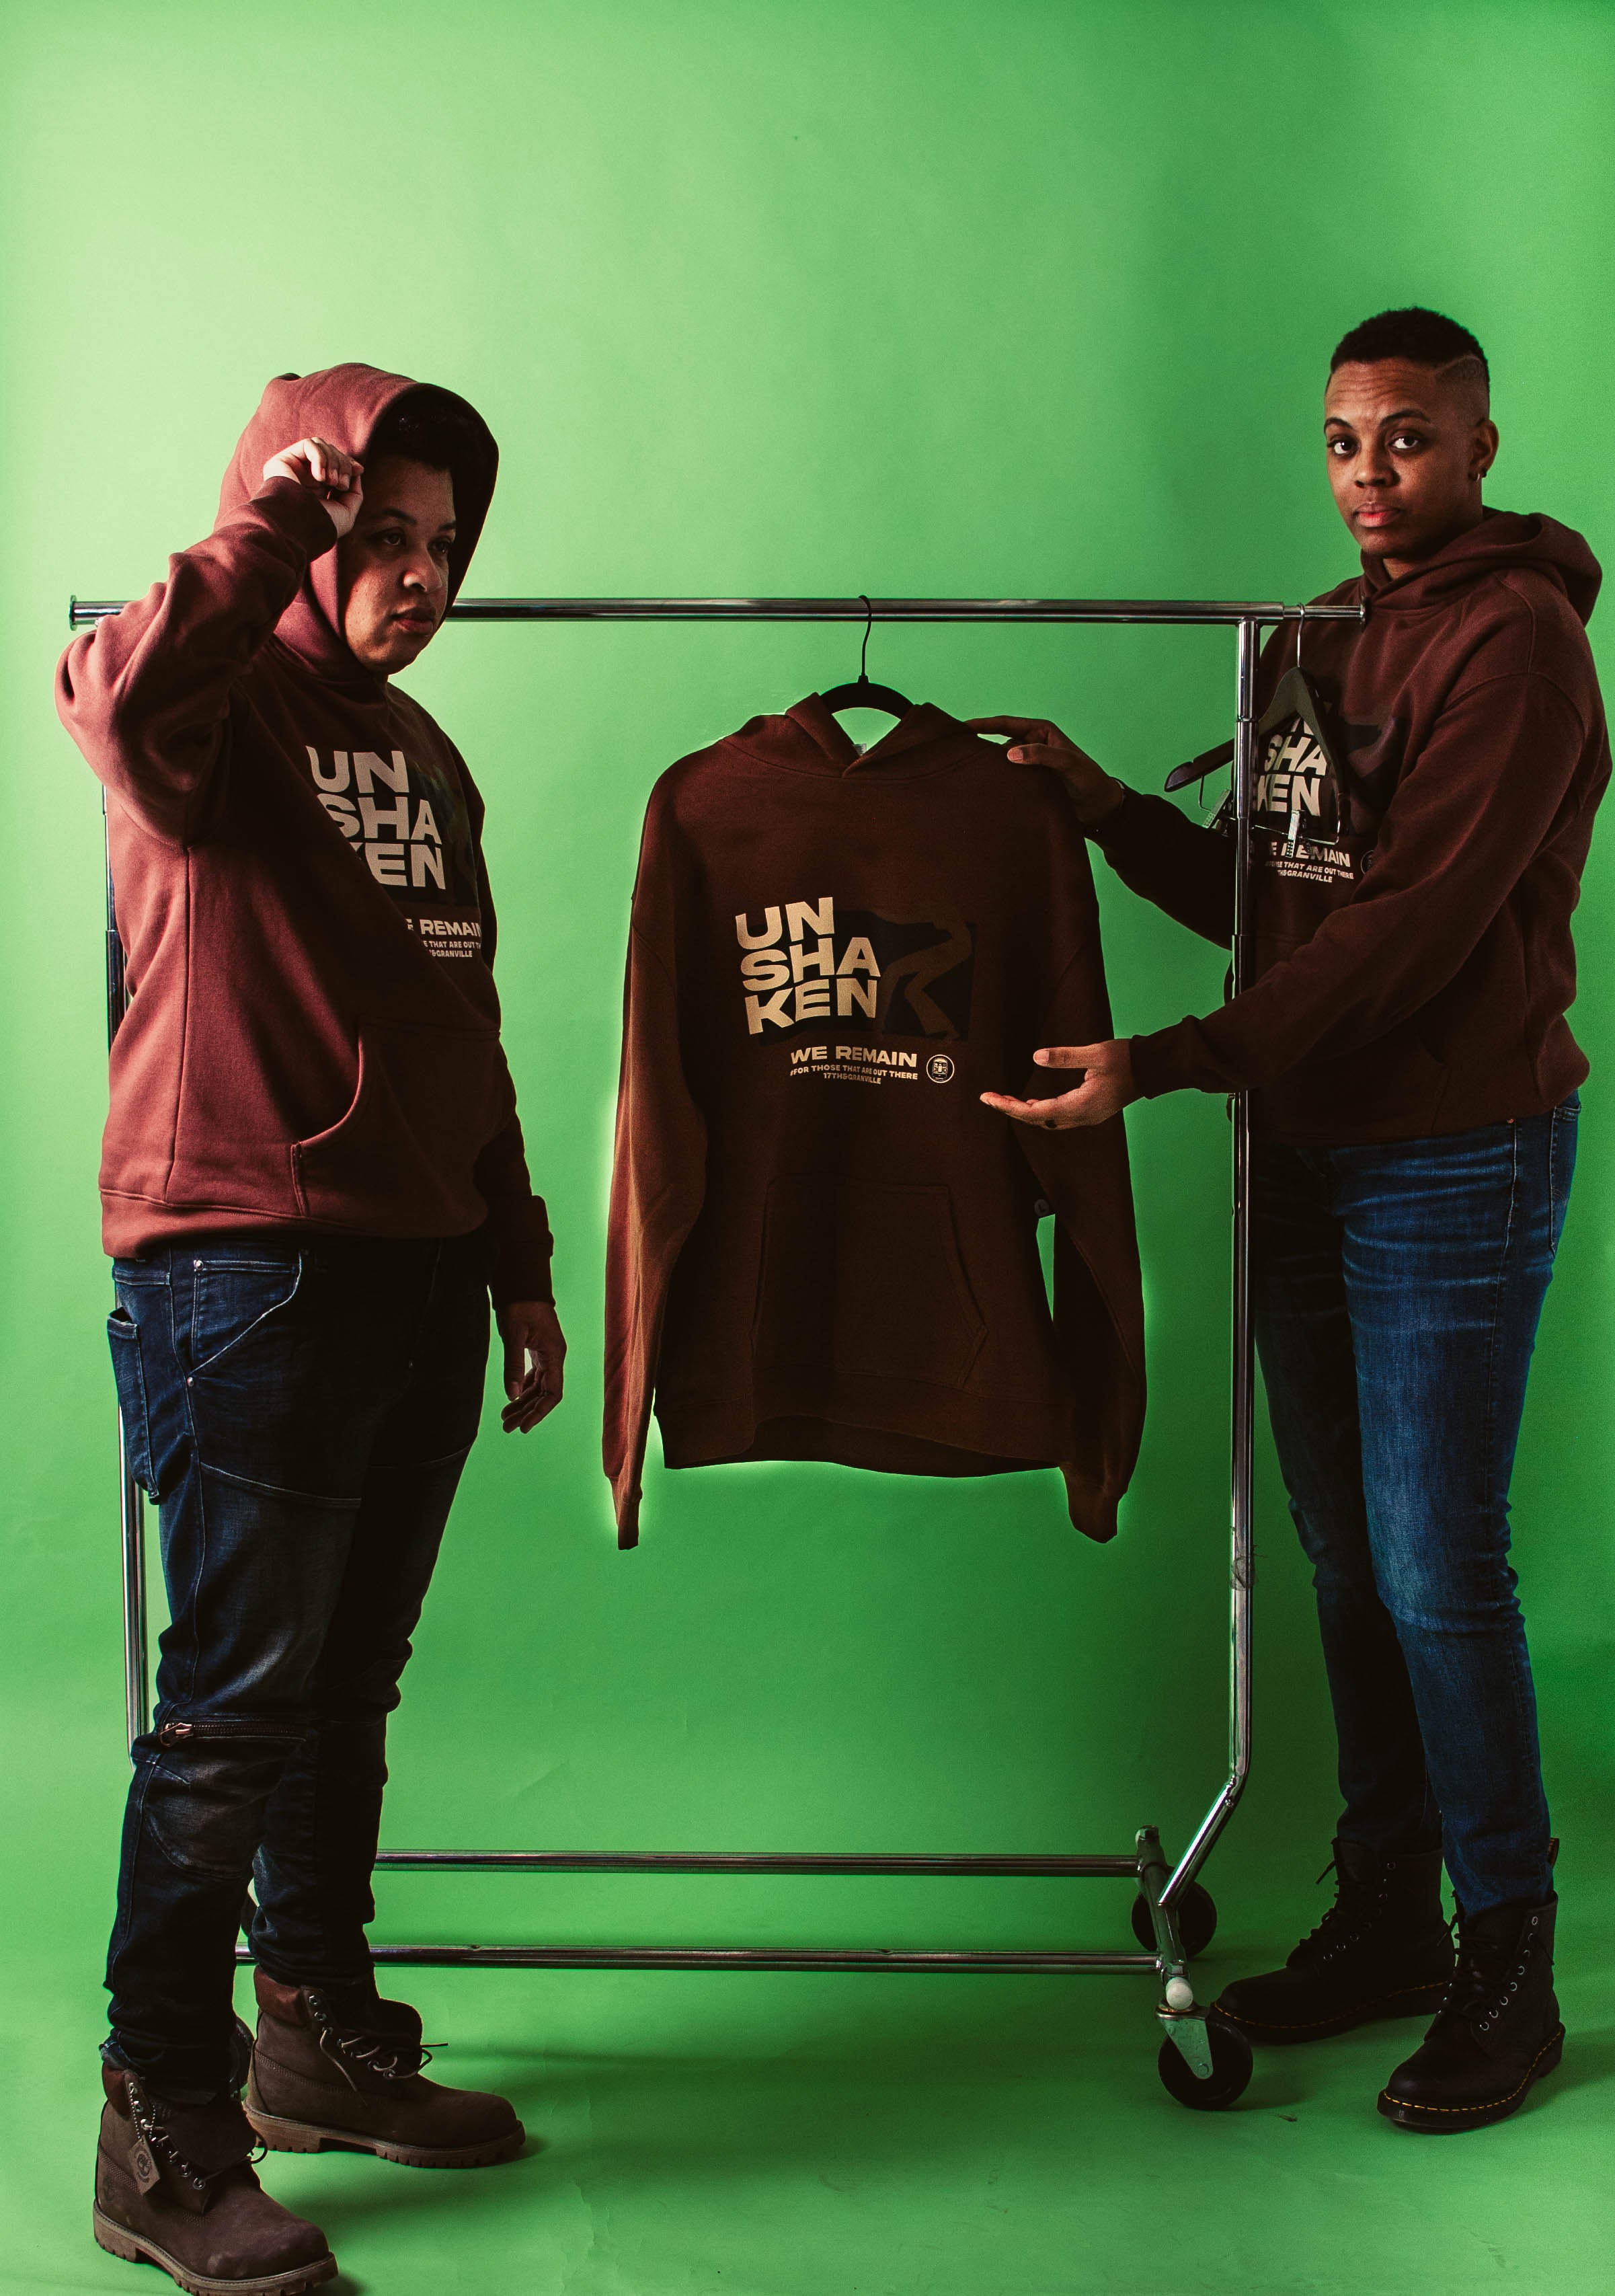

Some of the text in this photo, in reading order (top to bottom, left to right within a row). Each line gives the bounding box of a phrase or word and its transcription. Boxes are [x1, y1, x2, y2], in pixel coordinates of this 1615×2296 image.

[305, 745, 409, 793] UN
[317, 793, 442, 845] SHA
[349, 842, 446, 890] EN
[1284, 862, 1306, 870] THAT
[1306, 865, 1324, 873] ARE
[1325, 867, 1337, 876] OUT
[429, 940, 447, 948] THAT
[735, 896, 834, 950] UN
[740, 937, 881, 991] SHA
[744, 978, 877, 1035] KEN
[790, 1046, 917, 1068] WE REMAIN
[842, 1065, 861, 1073] THAT
[873, 1069, 888, 1077] OUT
[889, 1071, 918, 1080] THERE
